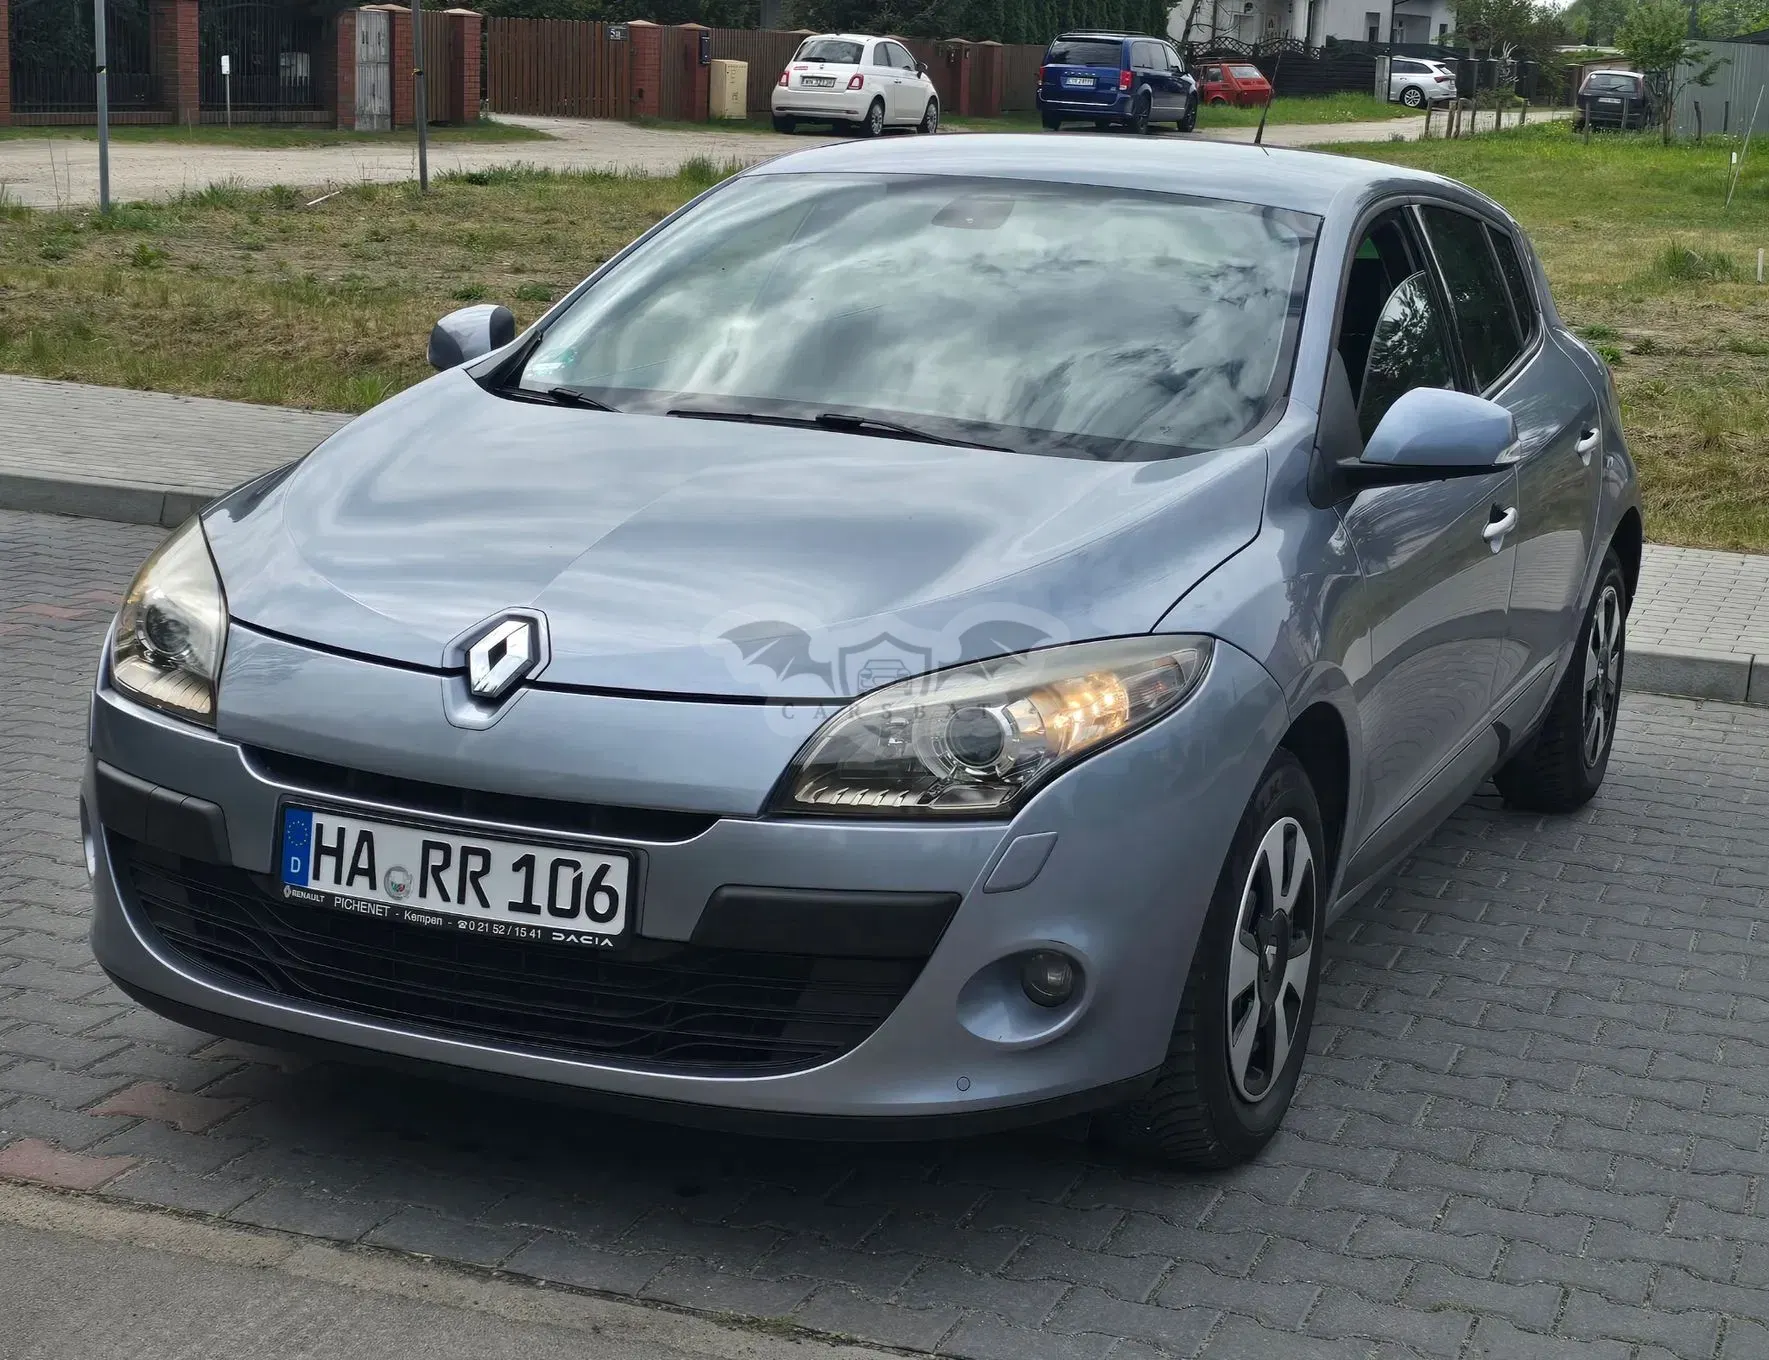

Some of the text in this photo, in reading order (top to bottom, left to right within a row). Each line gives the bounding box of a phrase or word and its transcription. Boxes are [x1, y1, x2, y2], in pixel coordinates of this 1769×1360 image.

[290, 856, 301, 873] D
[312, 822, 377, 891] HA
[419, 839, 492, 909] RR
[508, 853, 620, 924] 106
[291, 889, 326, 903] RENAULT
[334, 896, 392, 918] PICHENET
[404, 910, 443, 926] Kempen
[477, 922, 489, 933] 21
[492, 924, 505, 935] 52
[514, 927, 527, 938] 15
[529, 928, 542, 939] 41
[552, 932, 614, 947] DACIA
